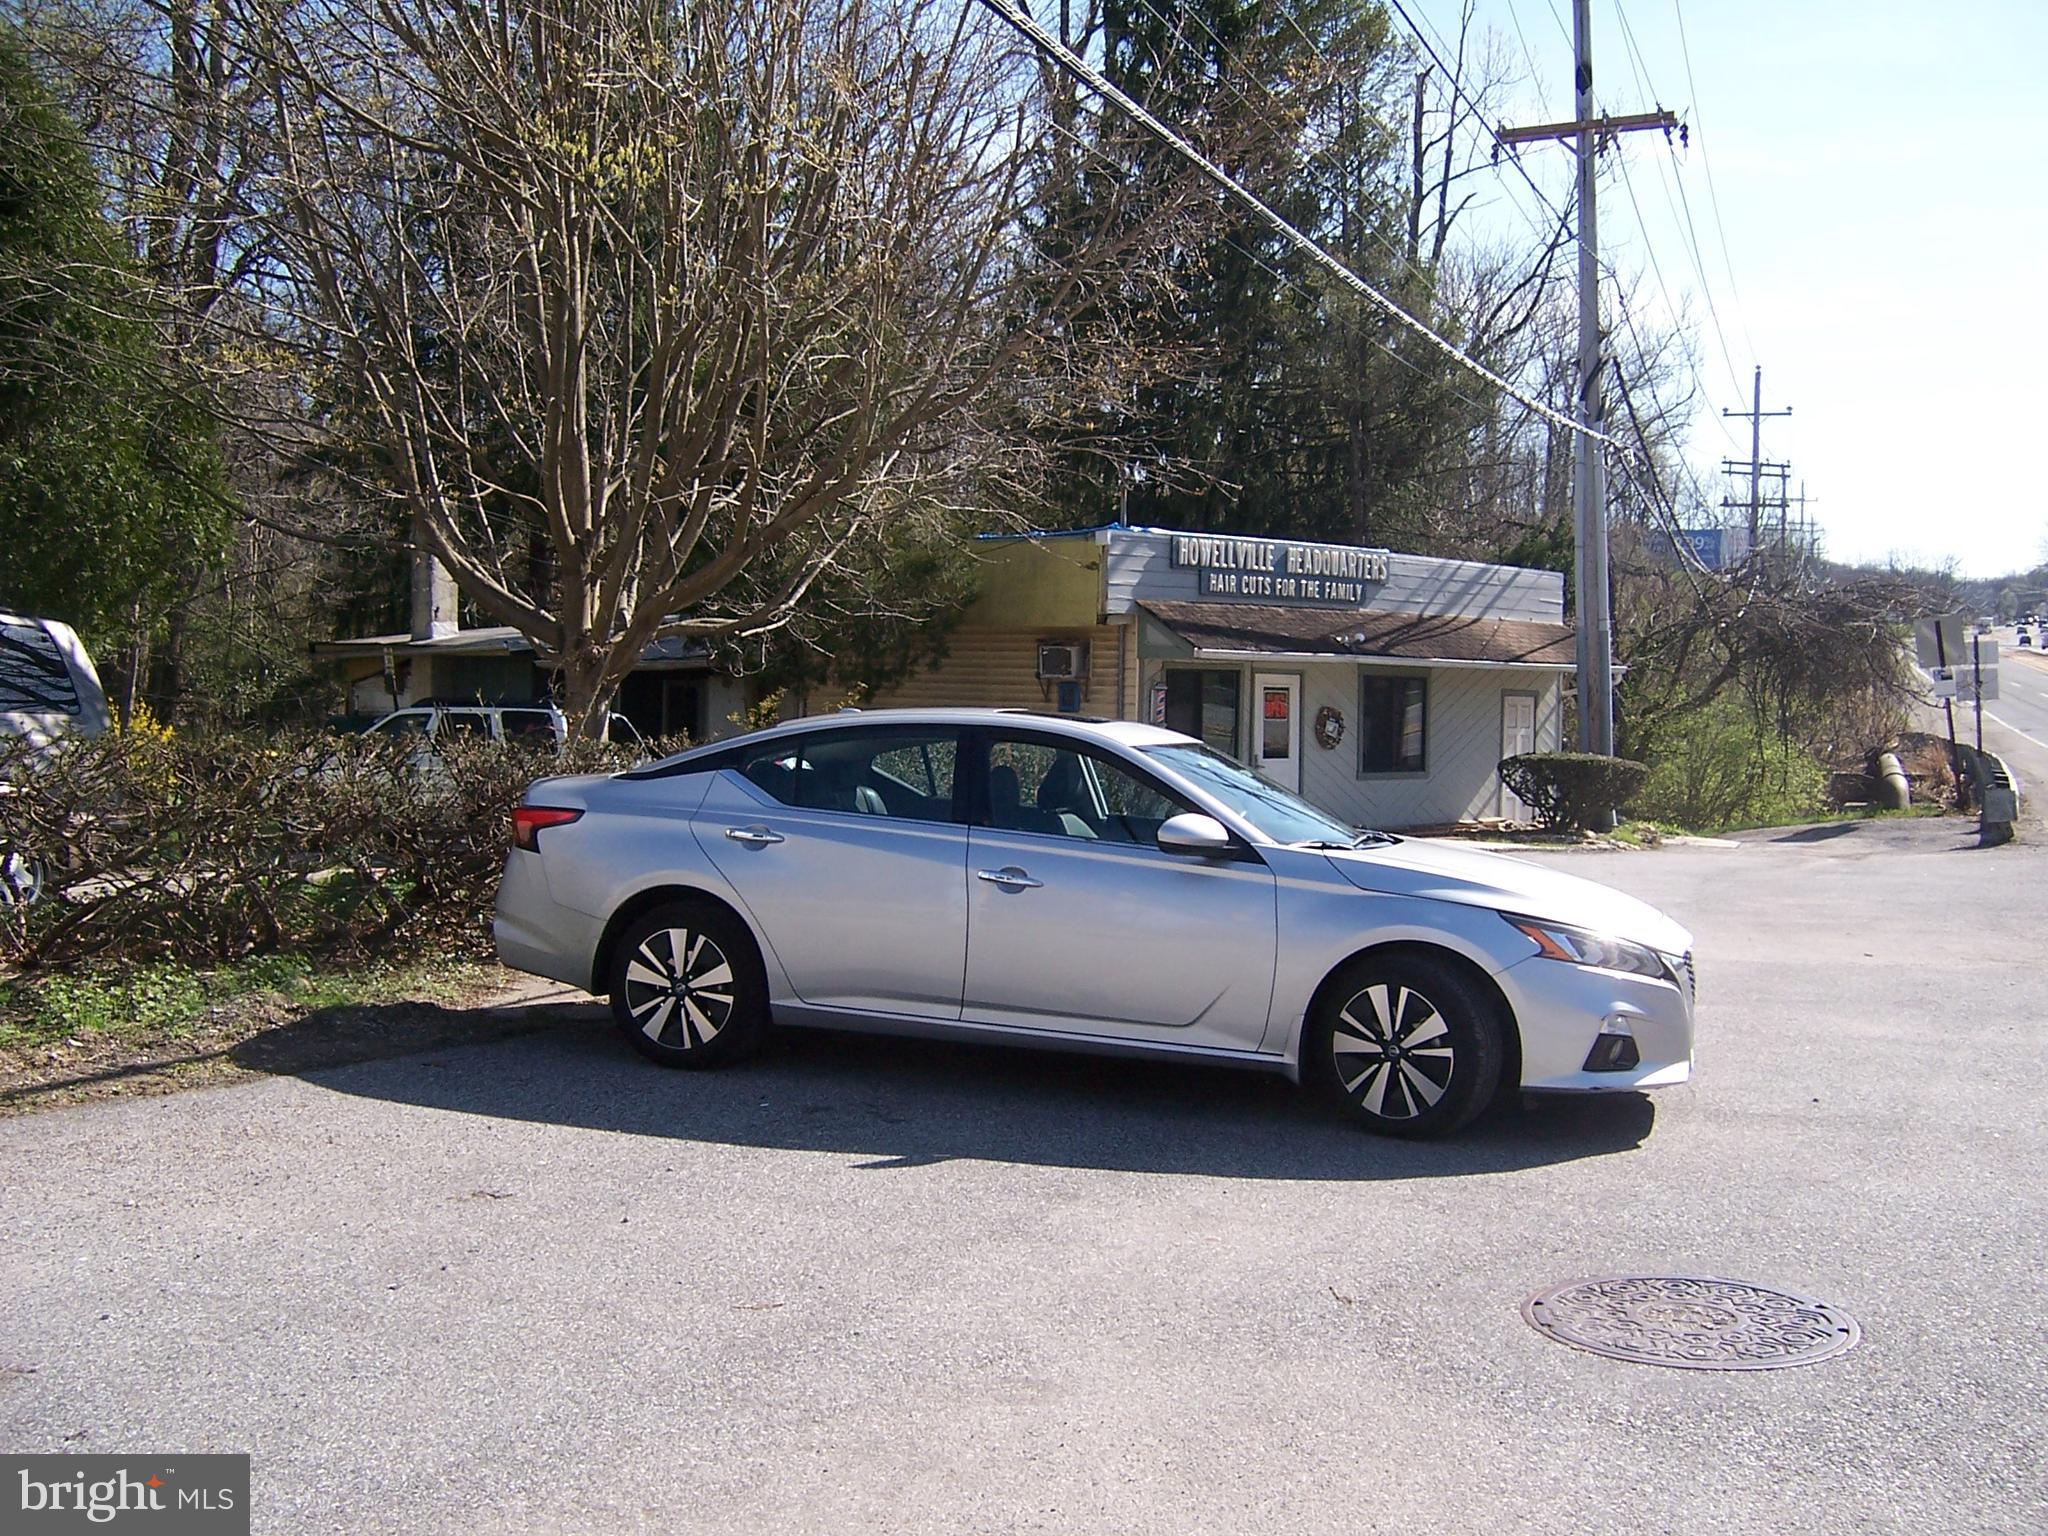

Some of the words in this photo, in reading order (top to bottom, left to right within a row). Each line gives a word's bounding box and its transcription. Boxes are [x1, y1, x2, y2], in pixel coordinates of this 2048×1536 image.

[1178, 537, 1275, 572] HOWELLVILLE
[1287, 546, 1388, 580] HEADQUARTERS
[1209, 573, 1237, 594] HAIR
[1242, 575, 1272, 595] CUTS
[1275, 578, 1296, 597] FOR
[1300, 579, 1320, 599] THE
[1325, 582, 1363, 602] FAMILY
